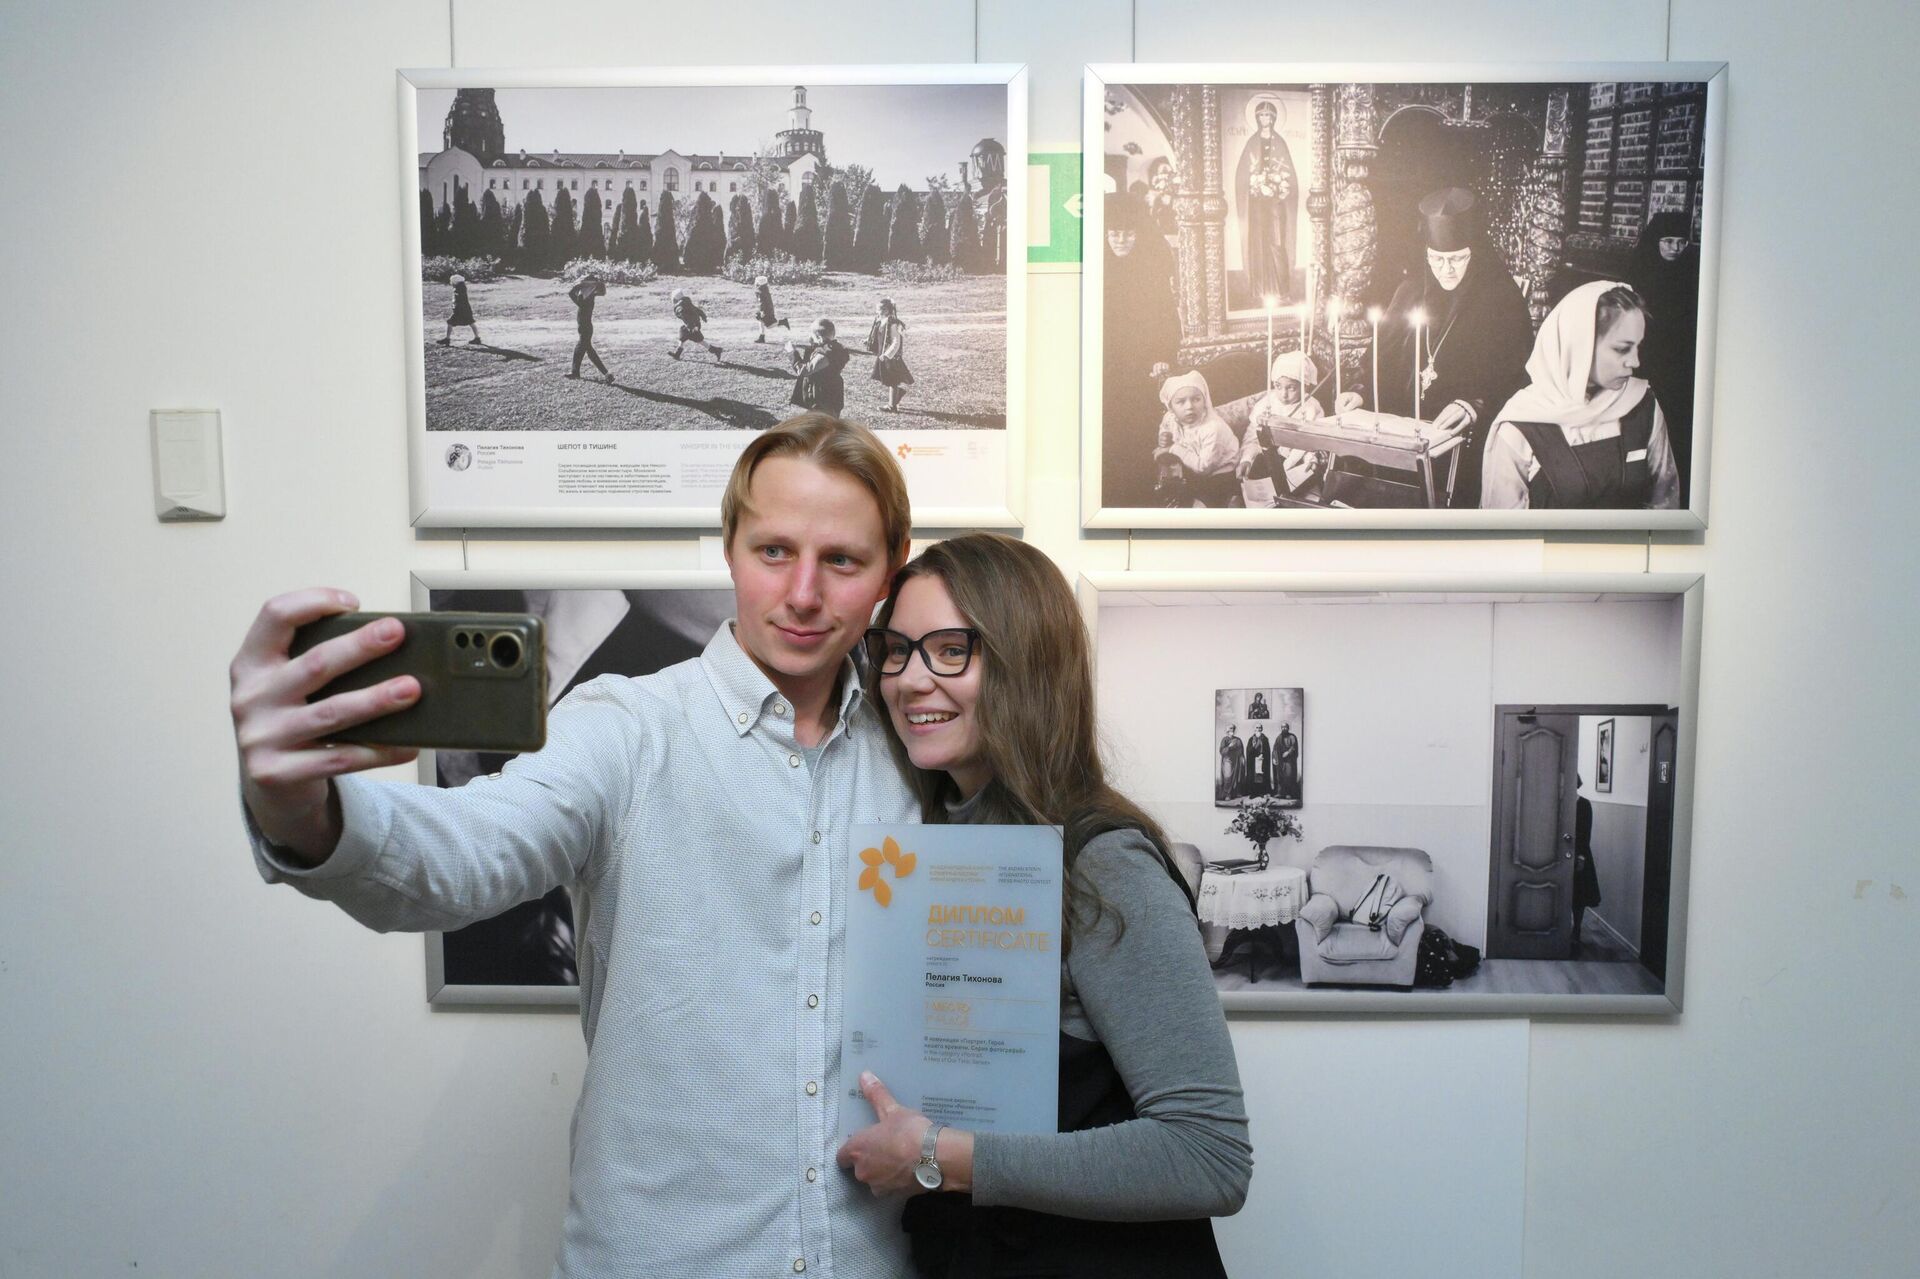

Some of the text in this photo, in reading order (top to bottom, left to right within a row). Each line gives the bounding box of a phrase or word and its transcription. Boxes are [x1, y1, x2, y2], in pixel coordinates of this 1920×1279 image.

[927, 903, 1025, 926] ДИПЛОМ
[926, 928, 1051, 953] CERTIFICATE
[926, 972, 1002, 984] Пелагия Тихонова
